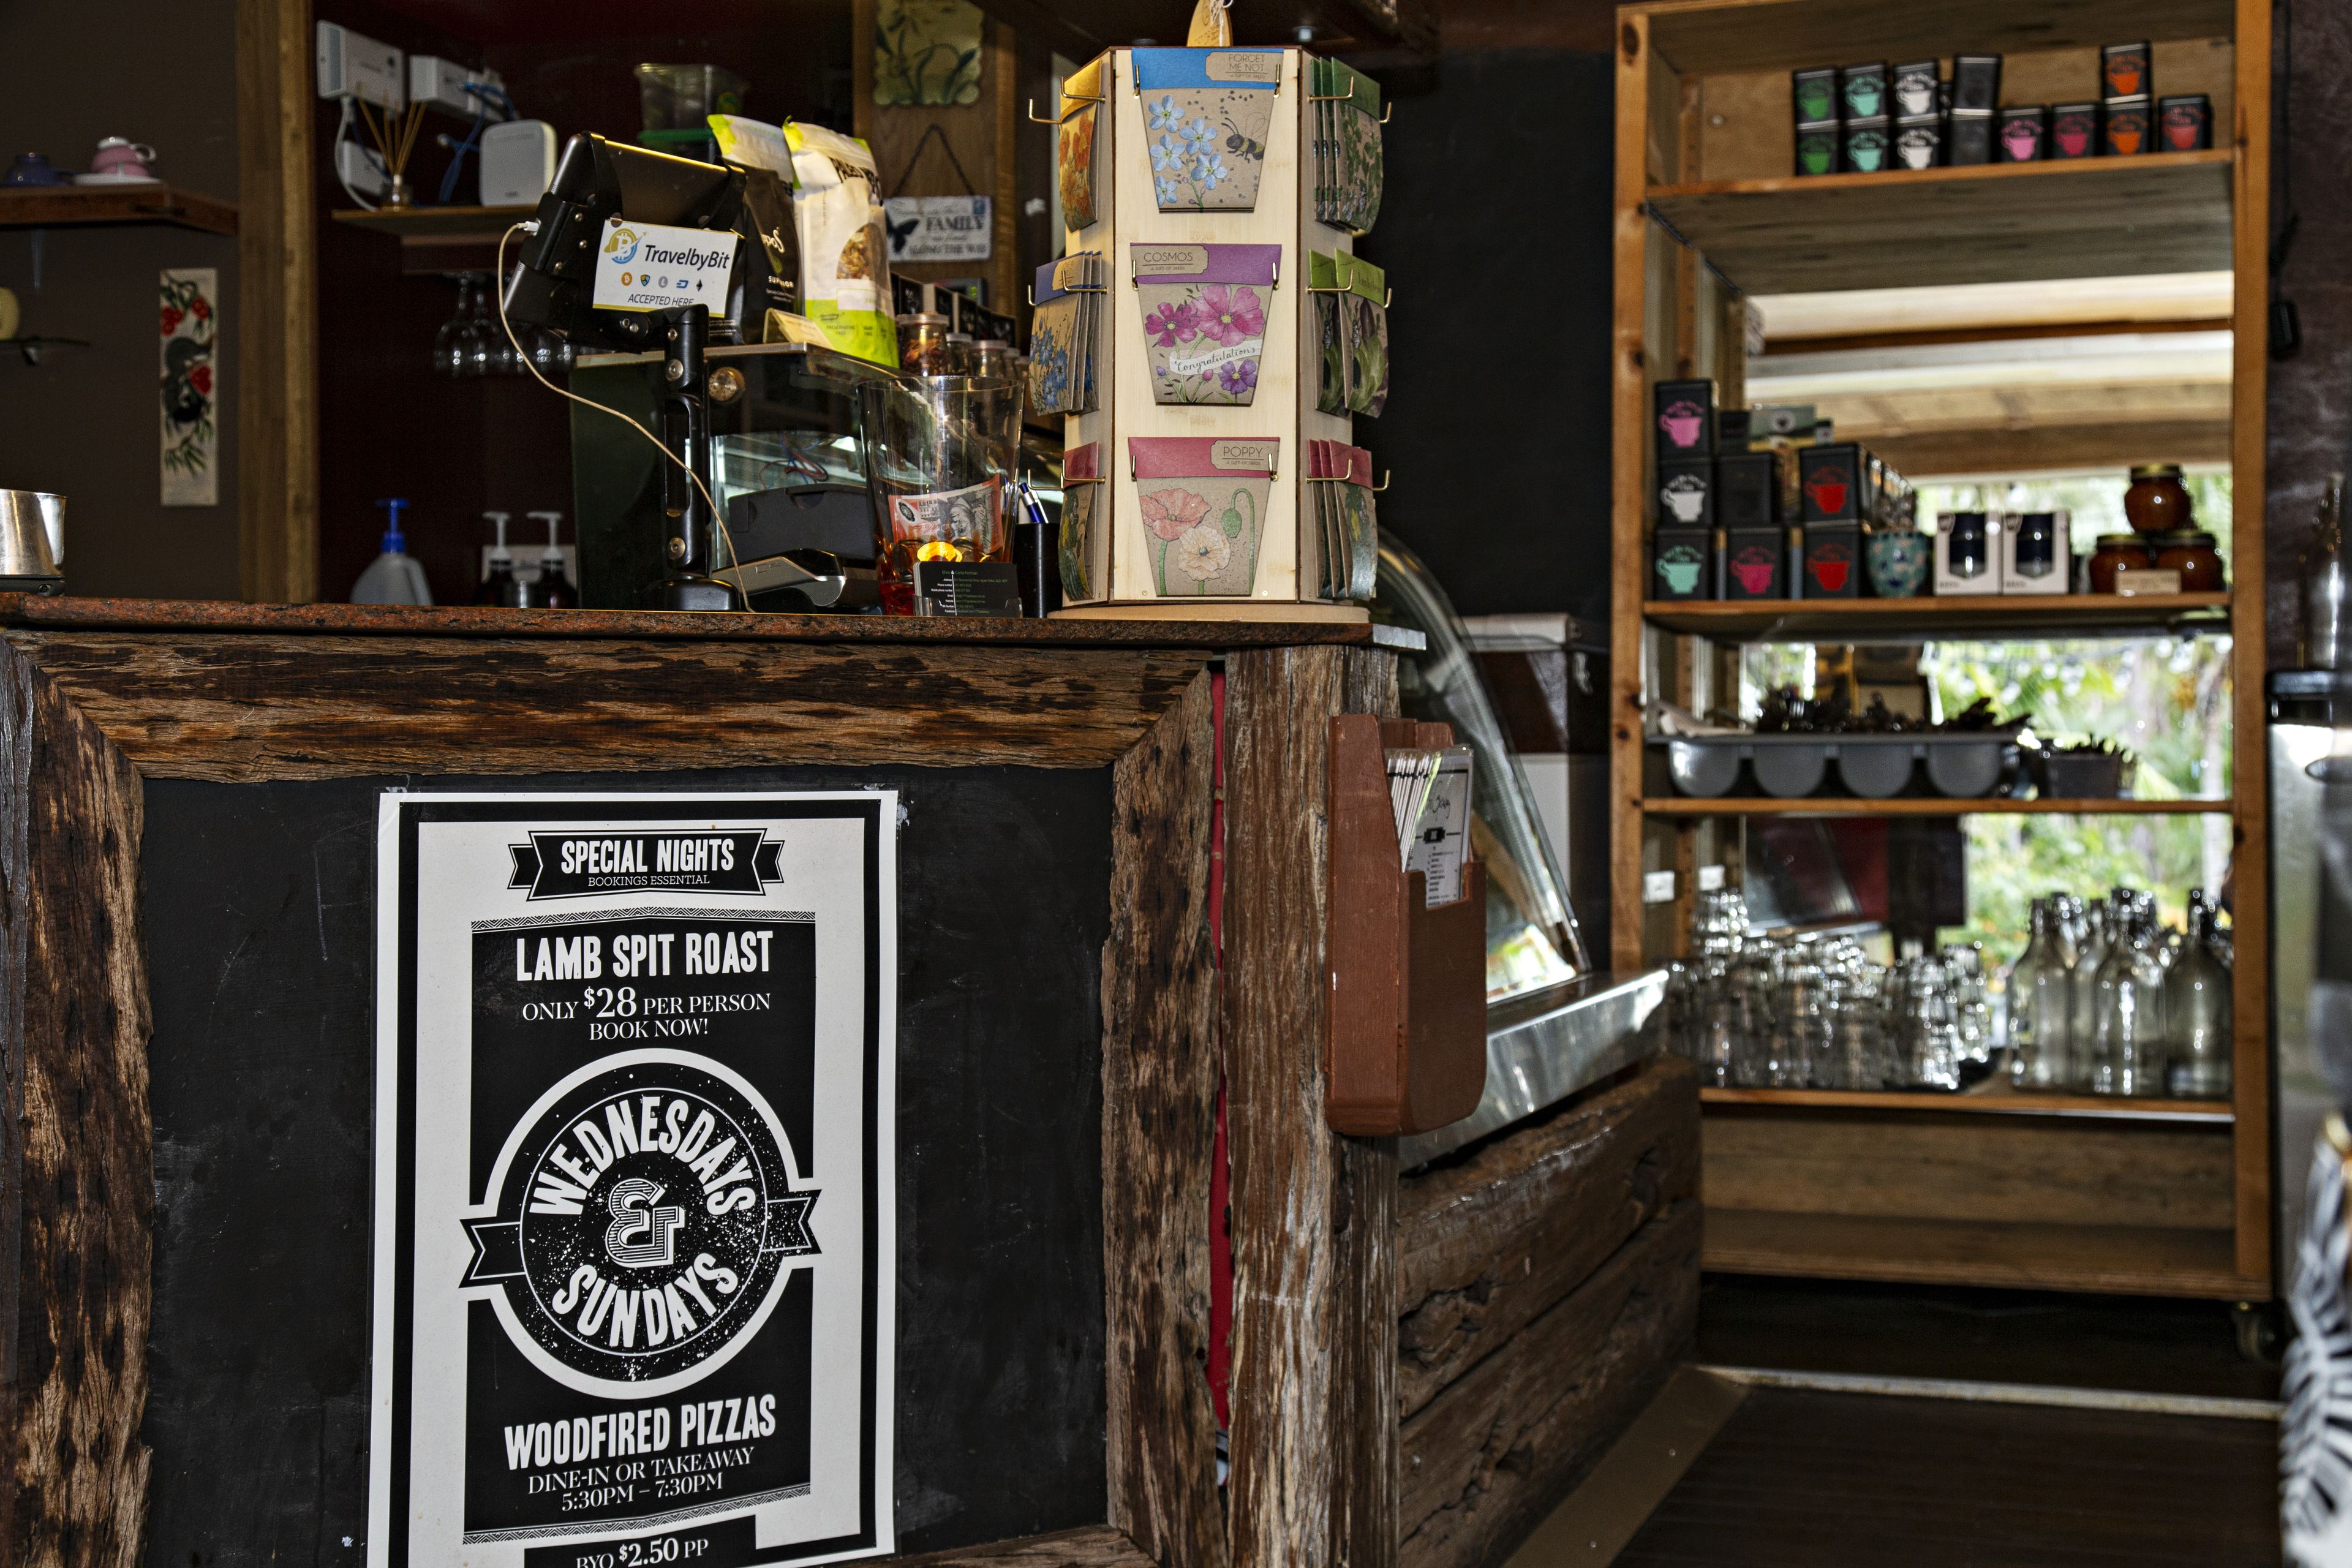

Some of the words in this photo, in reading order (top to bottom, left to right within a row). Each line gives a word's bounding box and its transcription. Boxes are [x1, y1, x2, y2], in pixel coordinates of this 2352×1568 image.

[1229, 53, 1265, 62] FORGET
[1245, 63, 1265, 72] NOT
[645, 244, 730, 271] TravelbyBit
[1144, 252, 1193, 262] COSMOS
[628, 293, 671, 306] ACCEPTED
[672, 298, 695, 306] HERE
[1172, 347, 1256, 374] Congratulations
[1223, 446, 1264, 458] POPPY
[561, 840, 648, 875] SPECIAL
[657, 839, 734, 872] NIGHTS
[588, 876, 648, 887] BOOKINGS
[650, 875, 710, 886] ESSENTIAL
[516, 936, 602, 981] LAMB
[612, 933, 674, 978] SPIT
[685, 930, 774, 975] ROAST
[522, 1001, 579, 1021] ONLY
[583, 986, 637, 1018] $28
[643, 997, 683, 1016] PER
[688, 993, 771, 1014] PERSON
[589, 1021, 649, 1041] BOOK
[654, 1018, 709, 1037] NOW!
[529, 1096, 756, 1216] WEDNESDAYS
[605, 1178, 685, 1268] &
[552, 1253, 739, 1348] SUNDAYS
[504, 1407, 671, 1470] WOODFIRED
[680, 1393, 777, 1449] PIZZAS
[528, 1466, 611, 1494] DINE-IN
[616, 1461, 646, 1482] OR
[650, 1447, 755, 1476] TAKEAWAY
[562, 1483, 635, 1512] 5:30PM
[655, 1472, 723, 1498] 7:30PM
[576, 1553, 614, 1568] BYO
[619, 1537, 679, 1567] $2.50
[684, 1539, 709, 1559] PP
